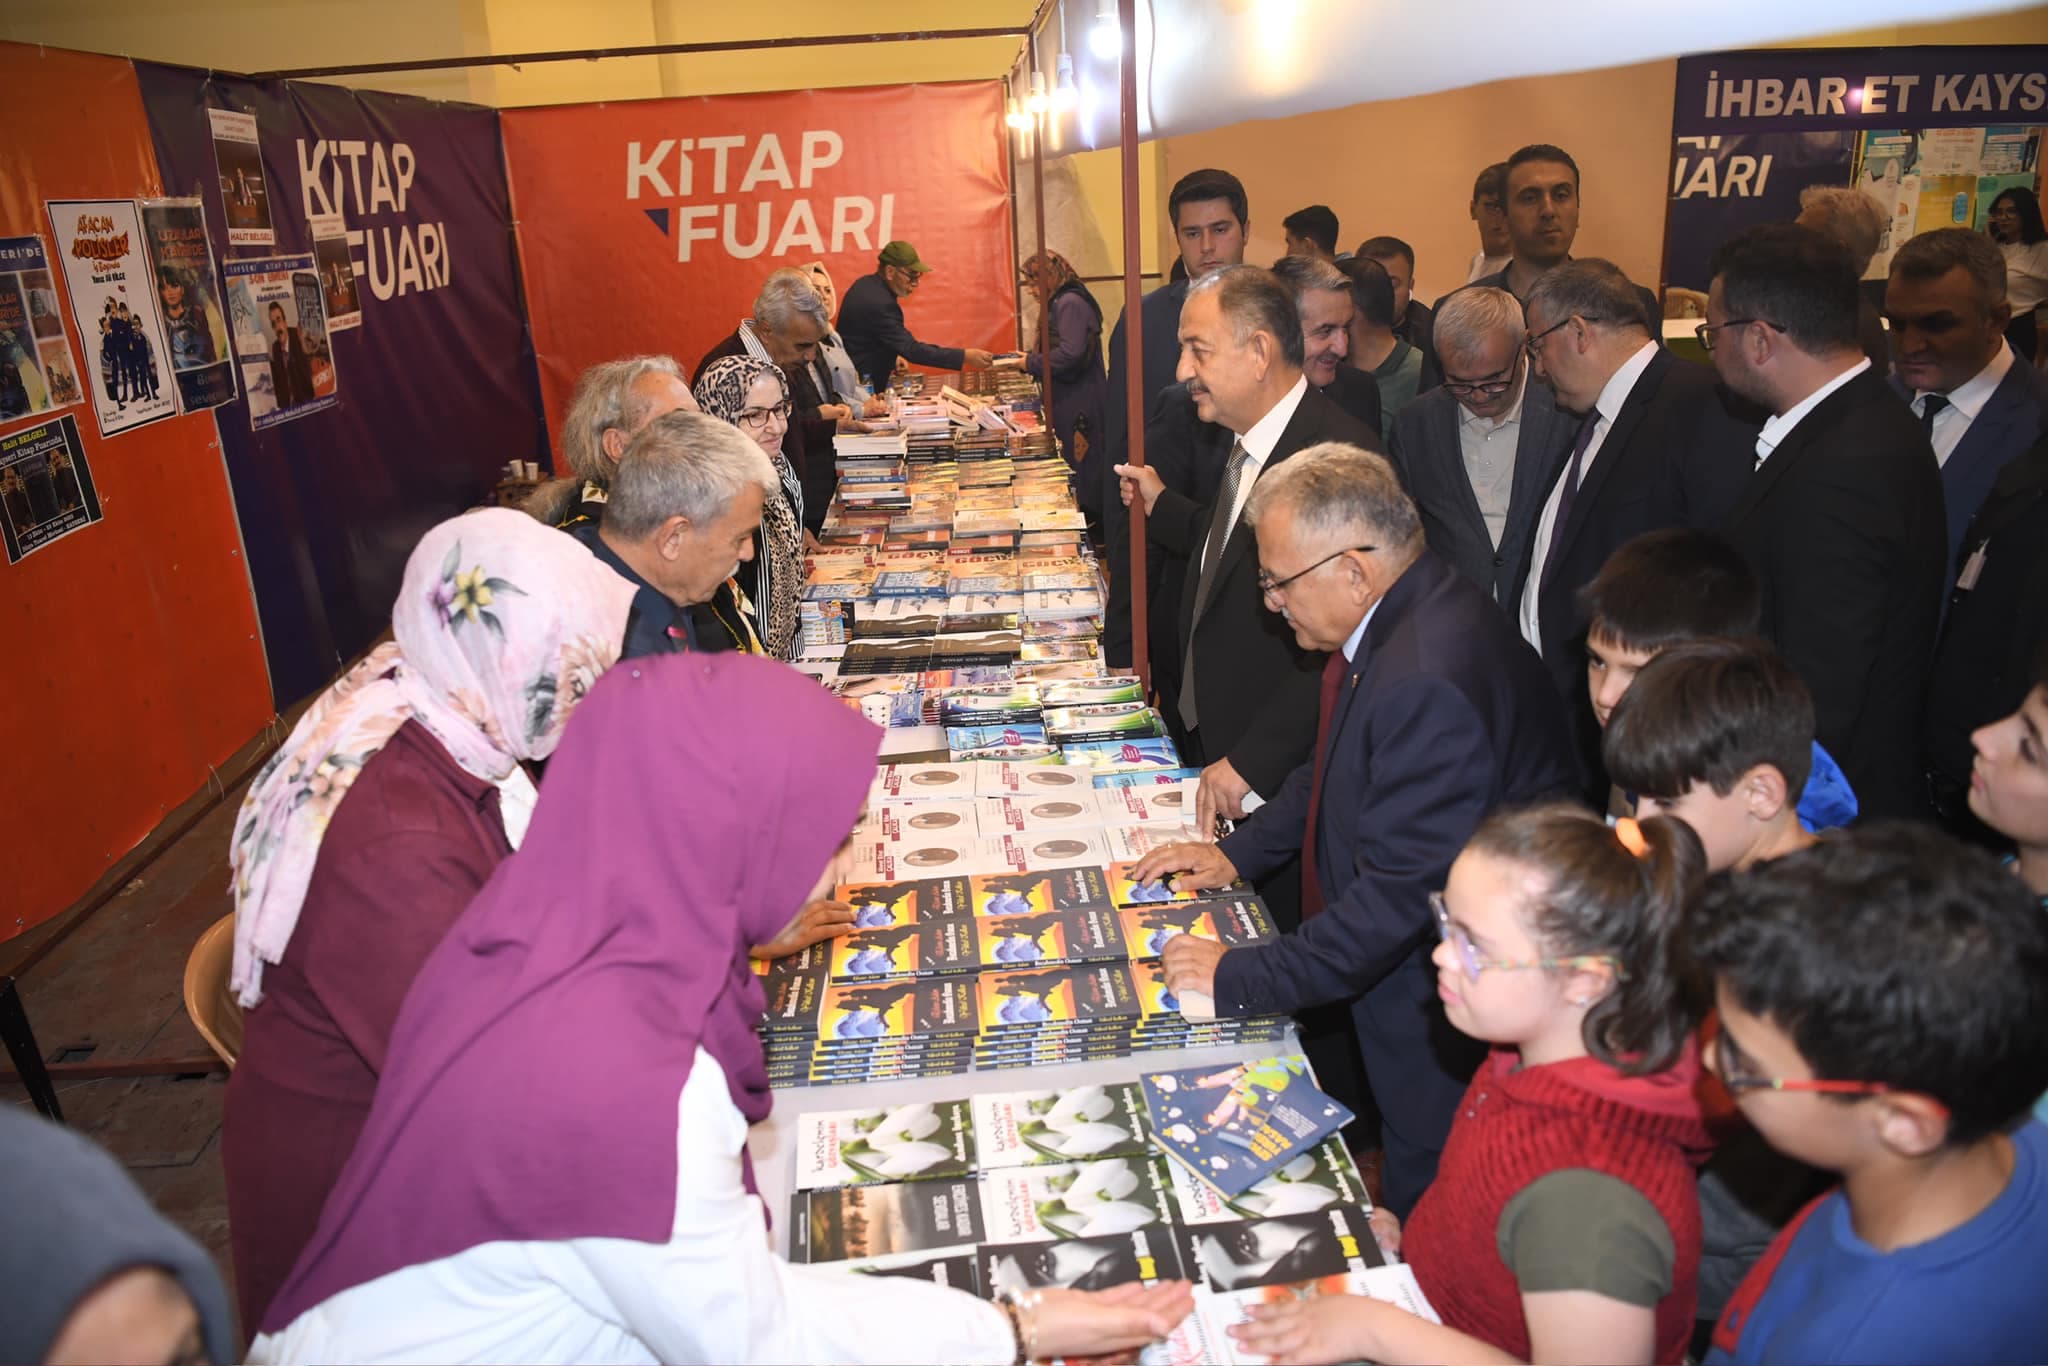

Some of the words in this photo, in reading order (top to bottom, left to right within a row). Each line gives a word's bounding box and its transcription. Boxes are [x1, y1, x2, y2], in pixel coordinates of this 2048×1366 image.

[1704, 70, 1847, 118] İHBAR
[1861, 75, 1920, 114] ET
[296, 139, 416, 220] KİTAP
[626, 130, 844, 200] KİTAP
[677, 193, 896, 263] FUARI
